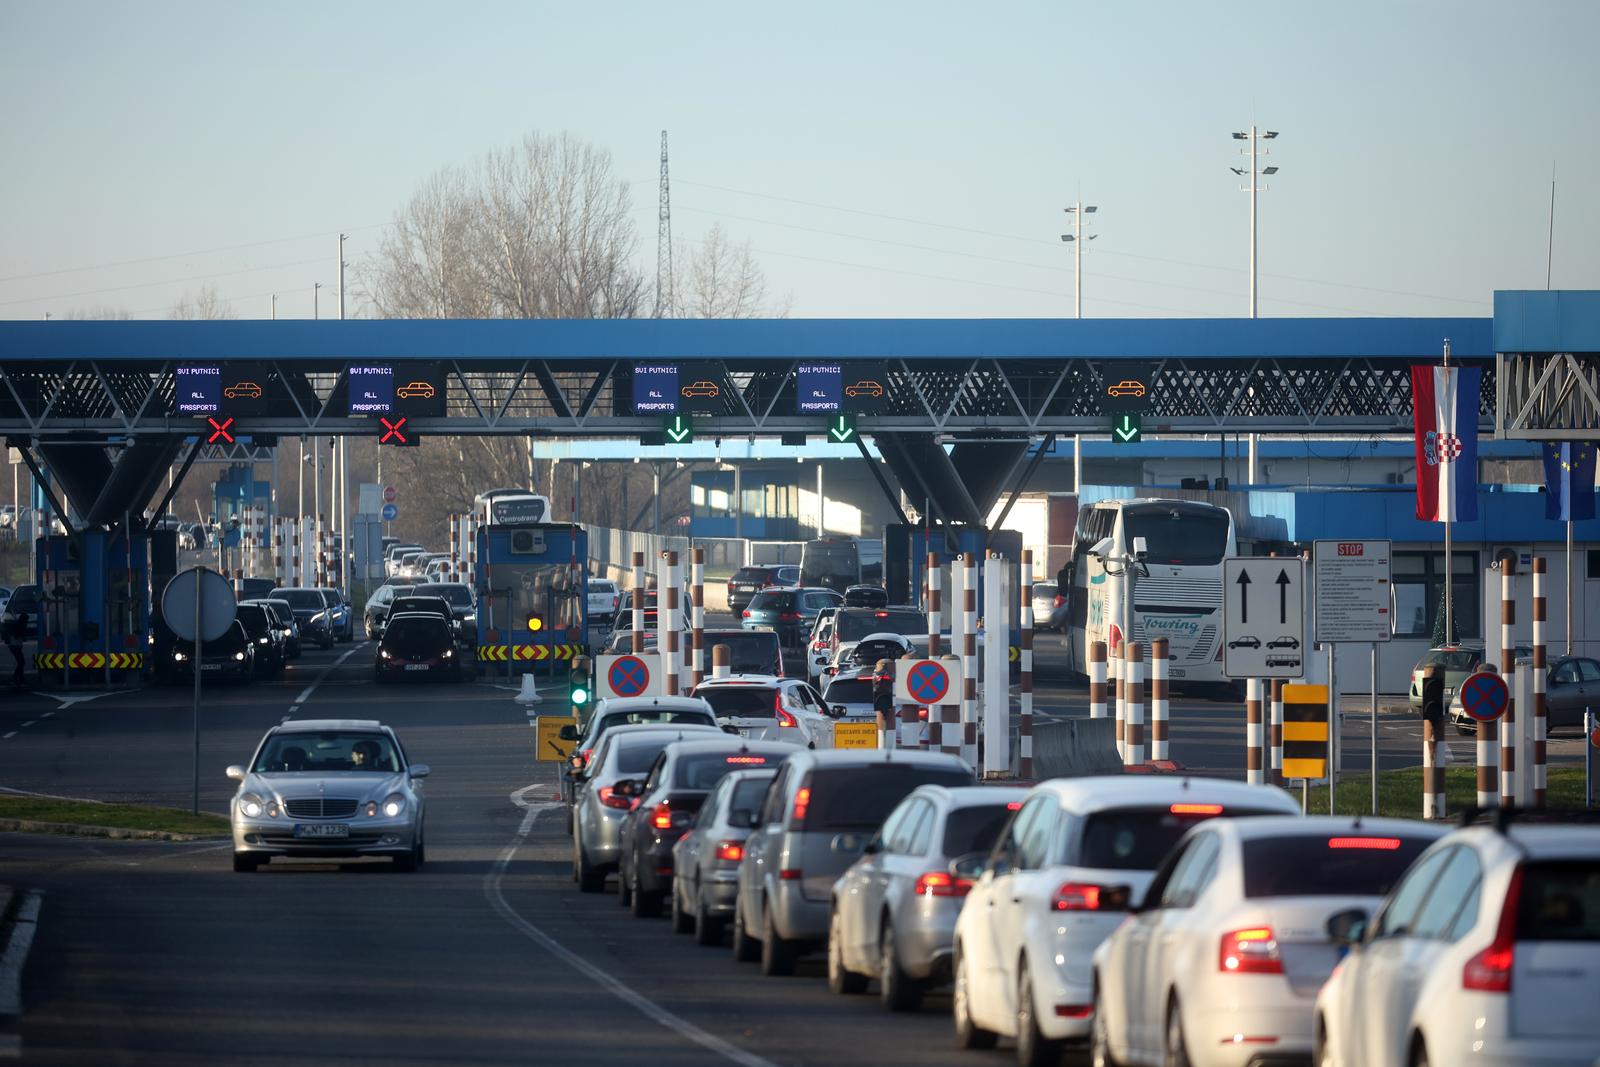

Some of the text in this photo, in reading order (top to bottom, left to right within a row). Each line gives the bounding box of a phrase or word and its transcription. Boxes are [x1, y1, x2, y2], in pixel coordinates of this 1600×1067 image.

[349, 367, 392, 375] SVI PUTNICI
[798, 366, 841, 374] SVI PUTNICI
[364, 391, 377, 399] ALL
[812, 390, 826, 398] ALL
[801, 402, 839, 410] PASSPORTS
[1338, 544, 1362, 555] STOP
[1143, 615, 1201, 634] Touring
